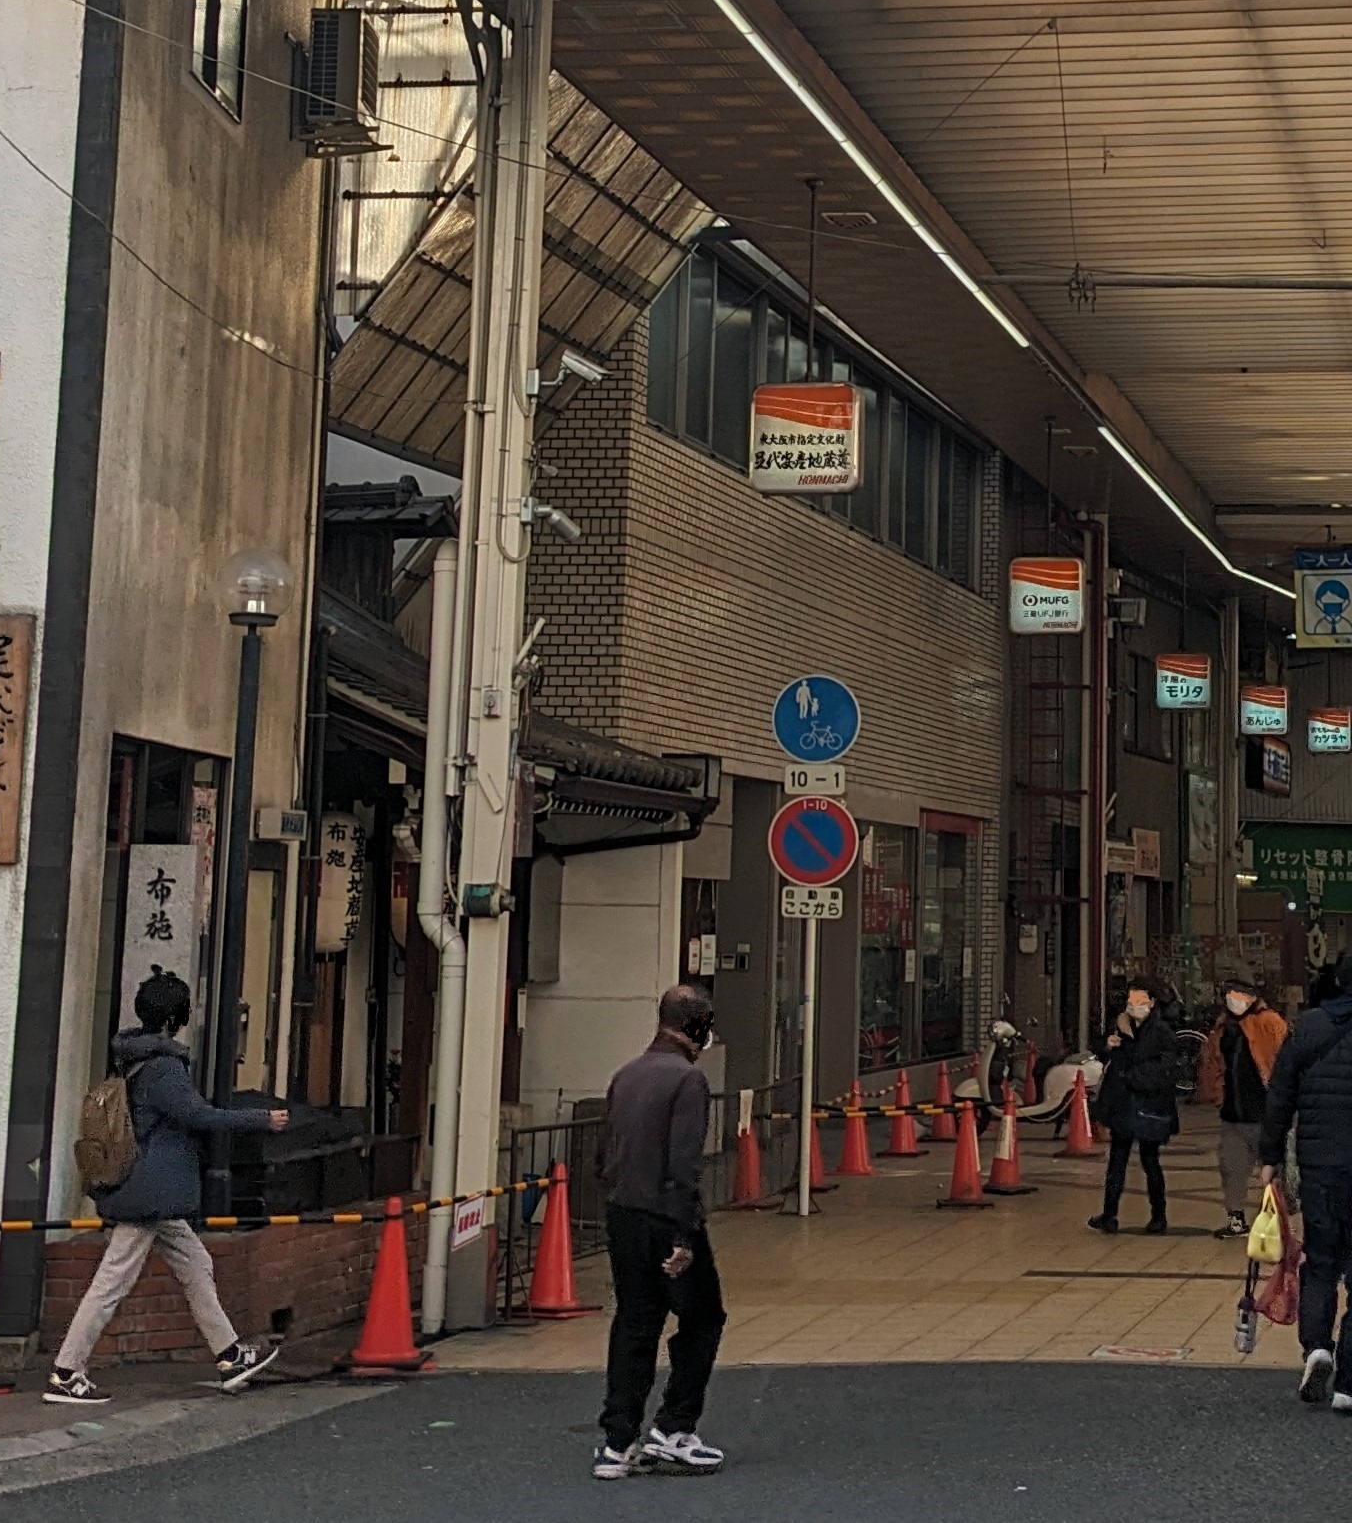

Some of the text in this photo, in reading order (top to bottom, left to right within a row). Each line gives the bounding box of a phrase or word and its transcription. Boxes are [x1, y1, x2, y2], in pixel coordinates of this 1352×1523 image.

[1039, 596, 1069, 605] MUFG
[1166, 685, 1203, 698] モリタ
[802, 799, 828, 811] 1-10
[326, 822, 348, 868] 布施
[144, 868, 176, 941] 布施
[784, 901, 840, 916] ここから
